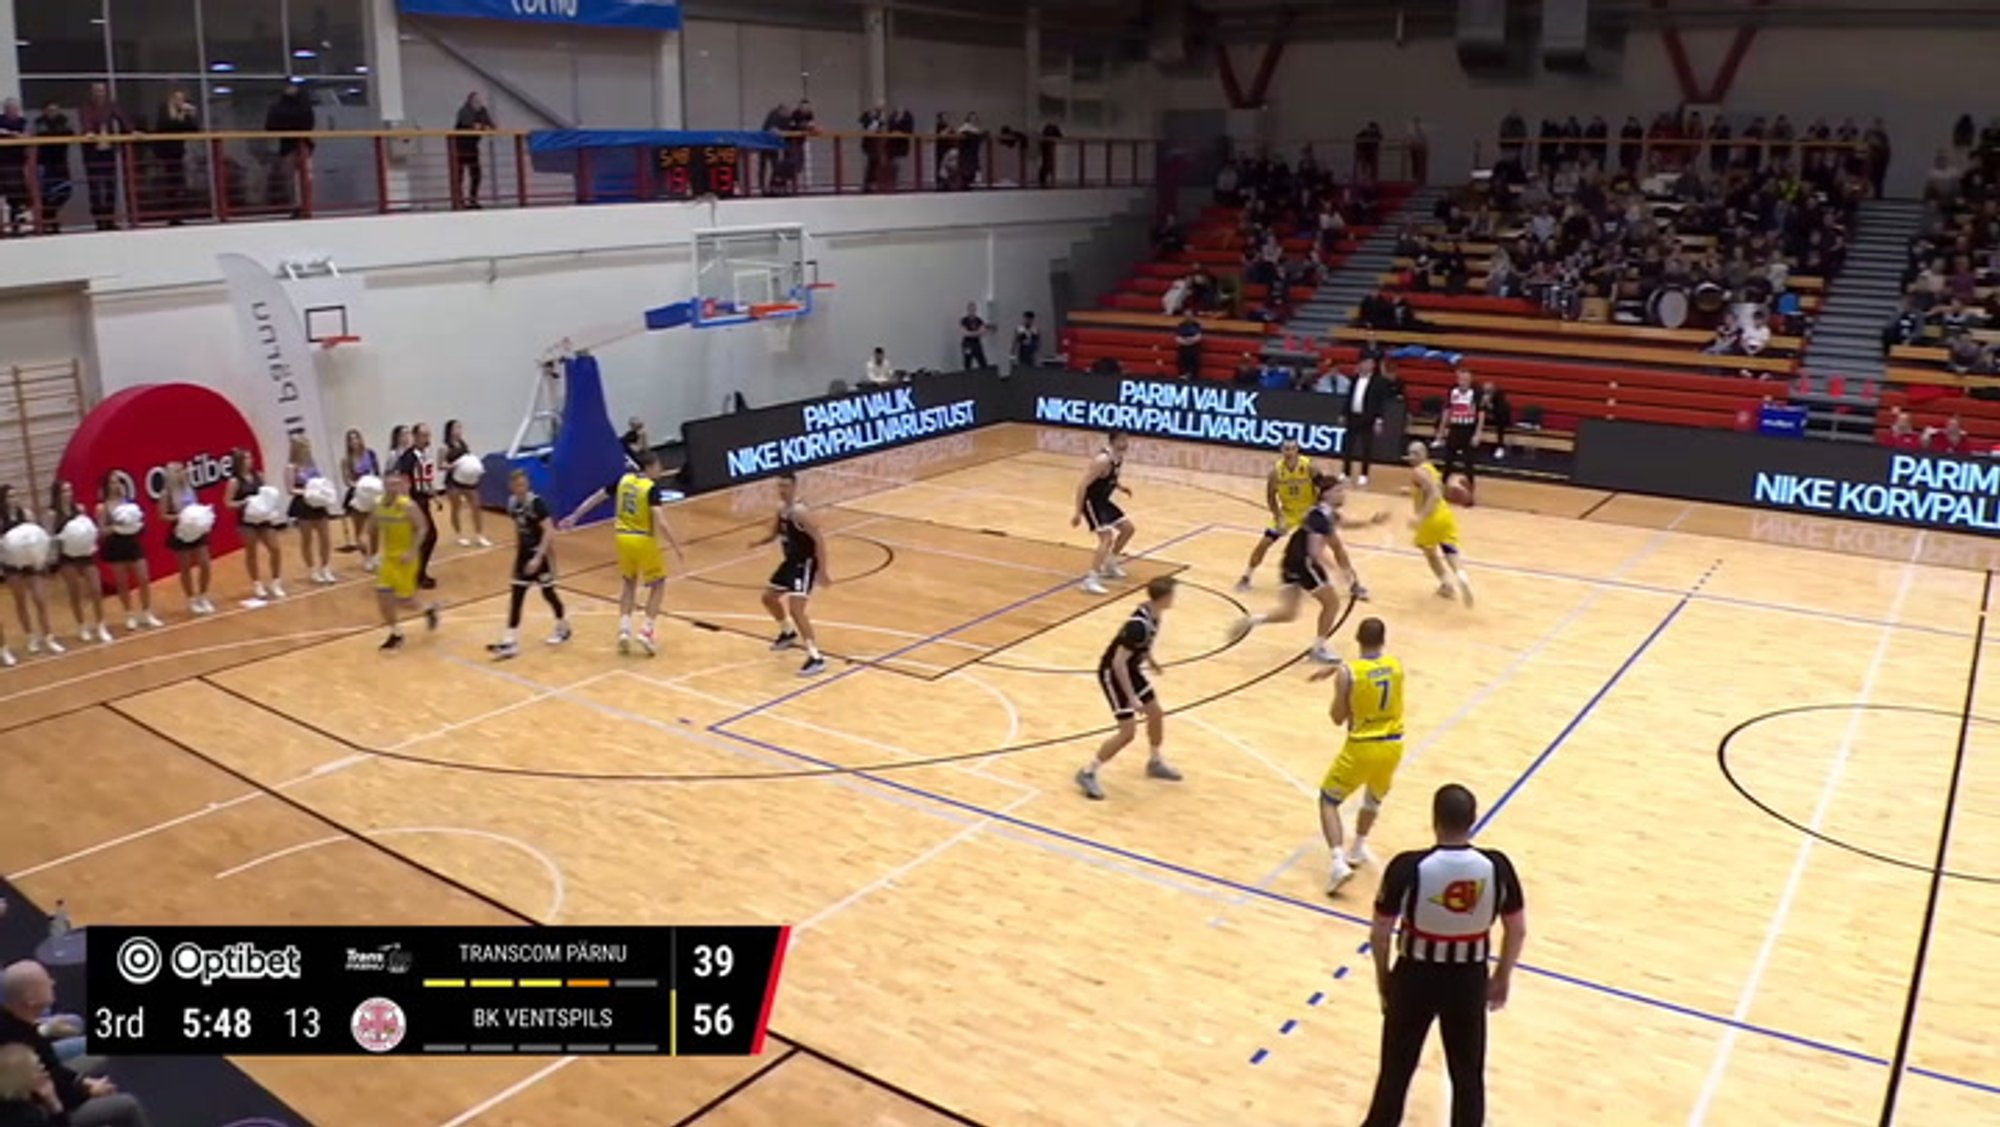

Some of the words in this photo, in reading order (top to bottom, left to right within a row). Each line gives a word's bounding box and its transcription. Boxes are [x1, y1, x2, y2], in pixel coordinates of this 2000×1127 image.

[803, 399, 867, 431] PARIM
[863, 387, 915, 419] VALIK
[1036, 397, 1086, 424] NIKE
[1121, 380, 1190, 409] PARIM
[1192, 385, 1257, 415] VALIK
[727, 442, 784, 478] NIKE
[781, 399, 975, 466] KORVPALLIVARUSTUST
[1890, 454, 2000, 496] PARIM
[1754, 472, 1836, 510] NIKE
[1838, 481, 2000, 530] KORVPAL
[1374, 679, 1390, 712] 7
